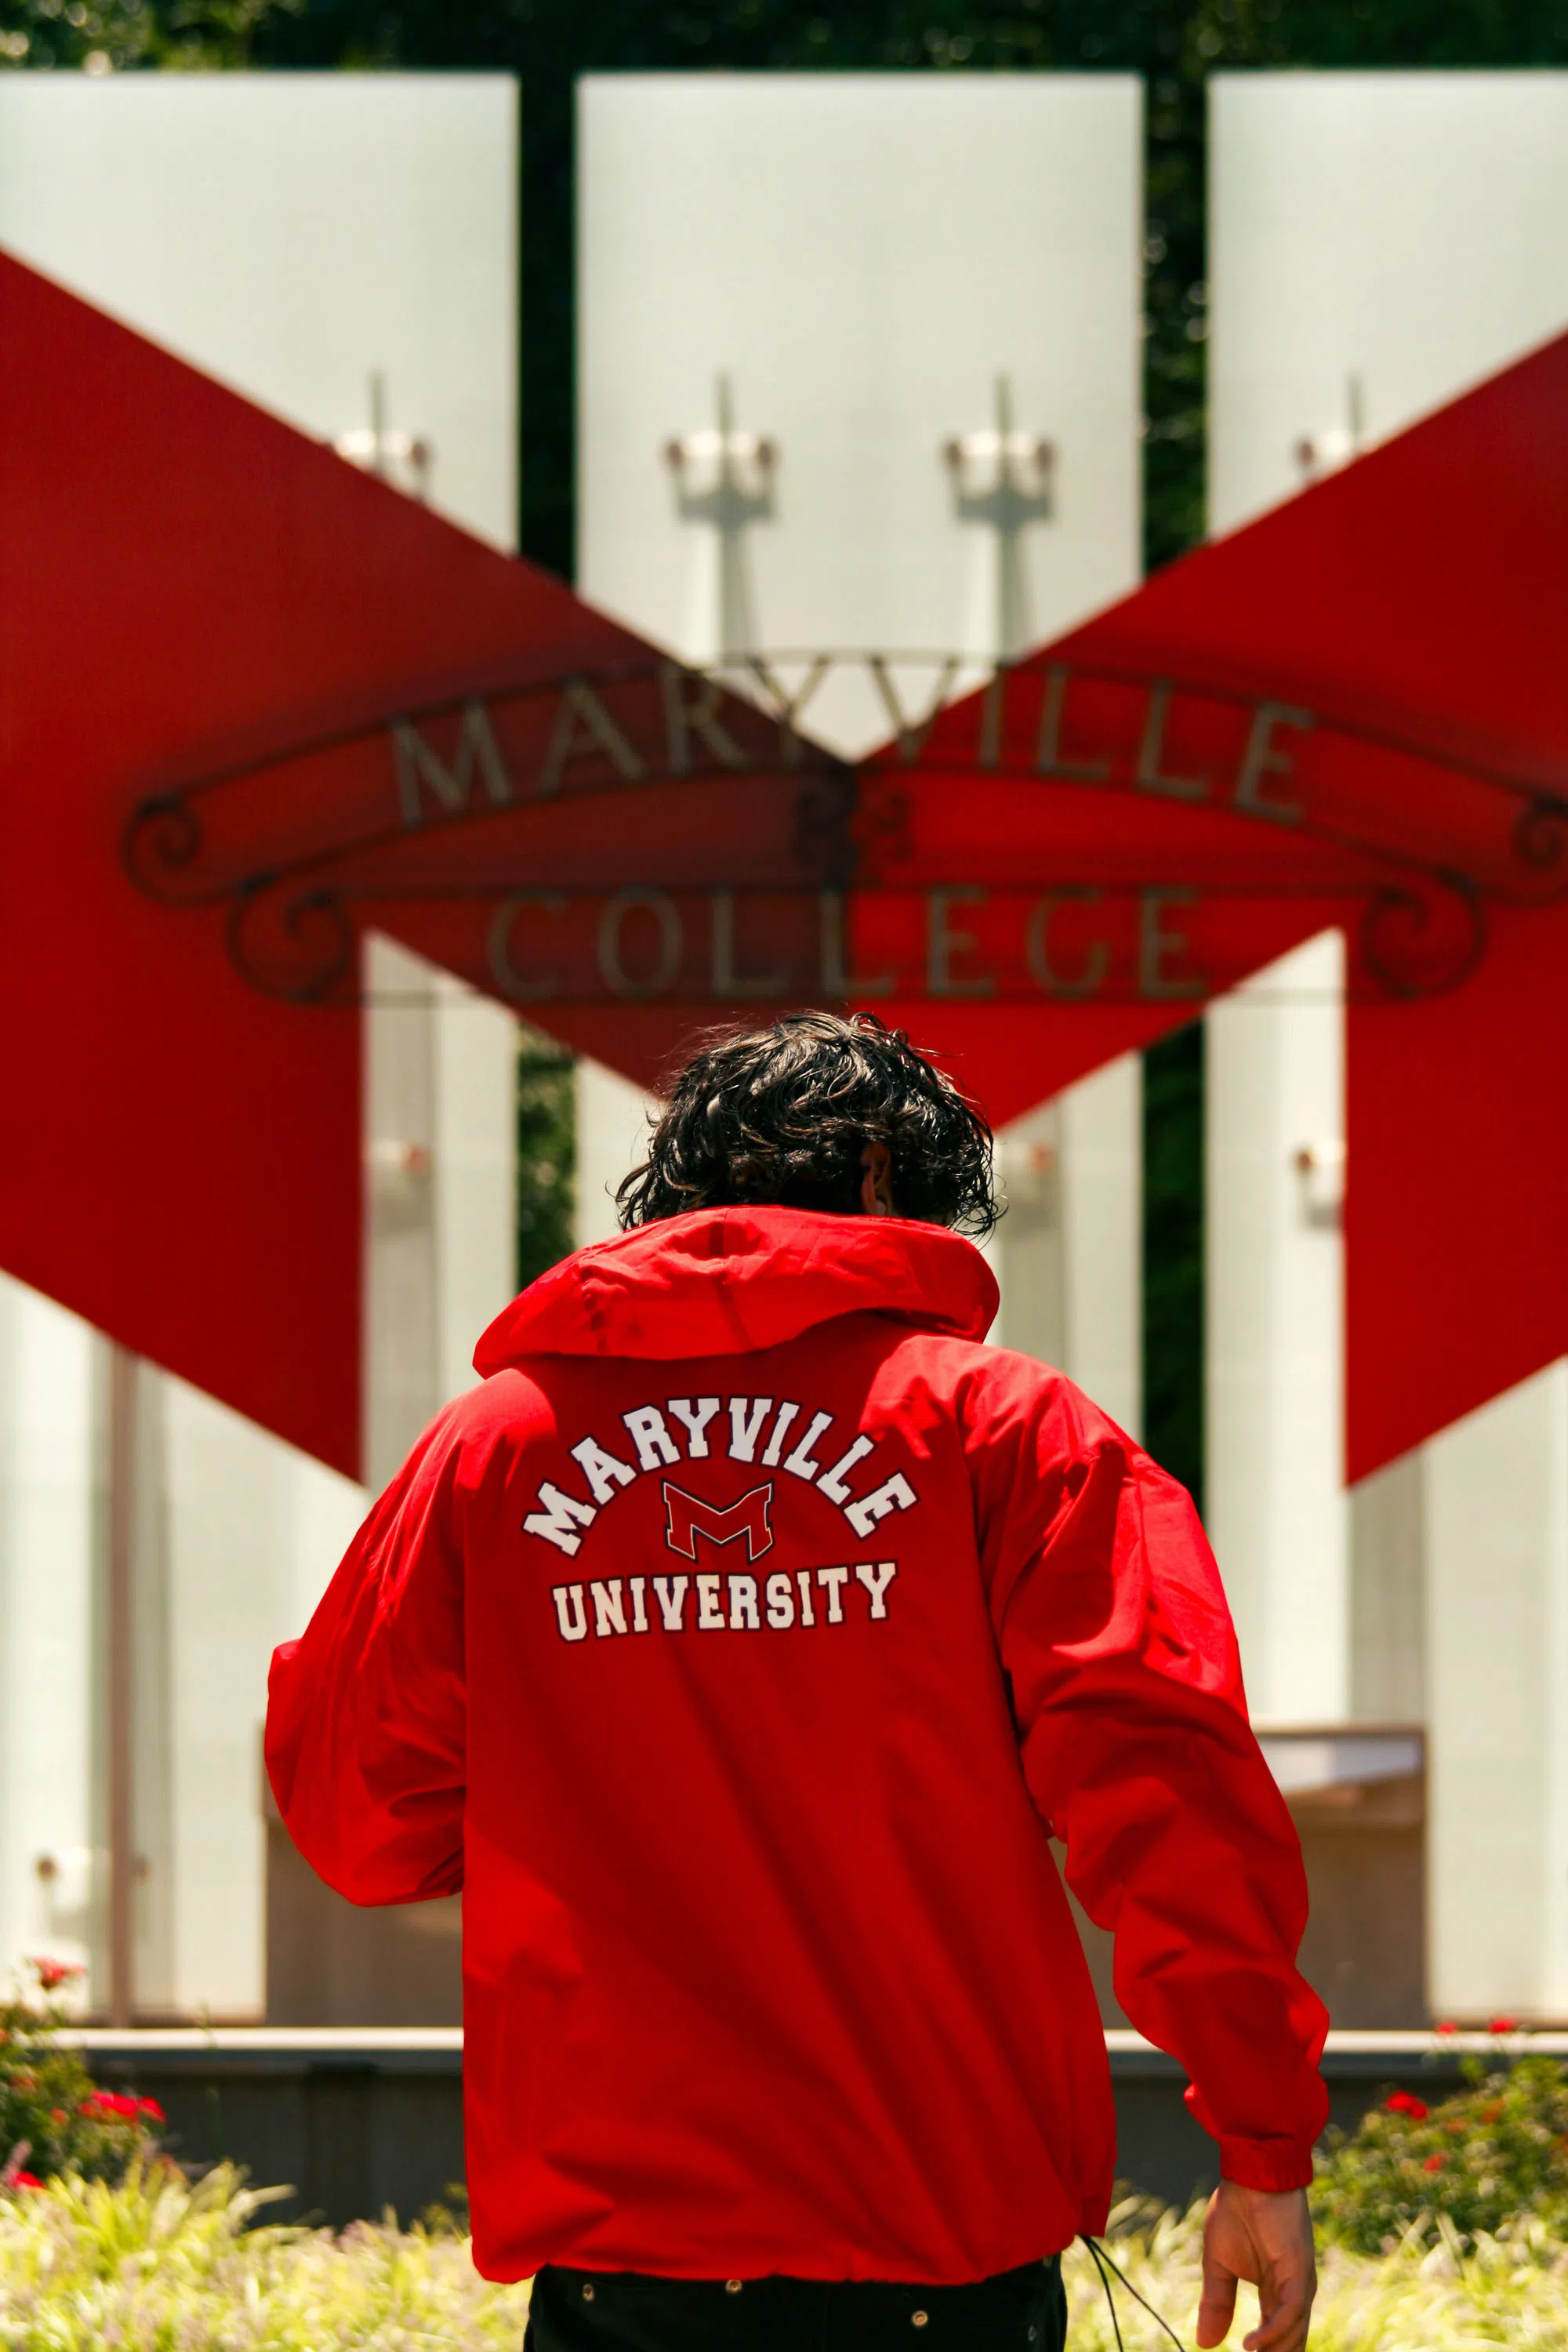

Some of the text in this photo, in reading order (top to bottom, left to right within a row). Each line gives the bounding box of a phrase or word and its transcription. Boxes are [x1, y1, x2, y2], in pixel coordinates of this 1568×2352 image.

[390, 654, 1316, 828] MARYVILLE
[488, 885, 1209, 1001] COLLEGE
[523, 1397, 917, 1557] MARYVILLE
[662, 1480, 773, 1563] M
[553, 1563, 897, 1641] UNIVERSITY
